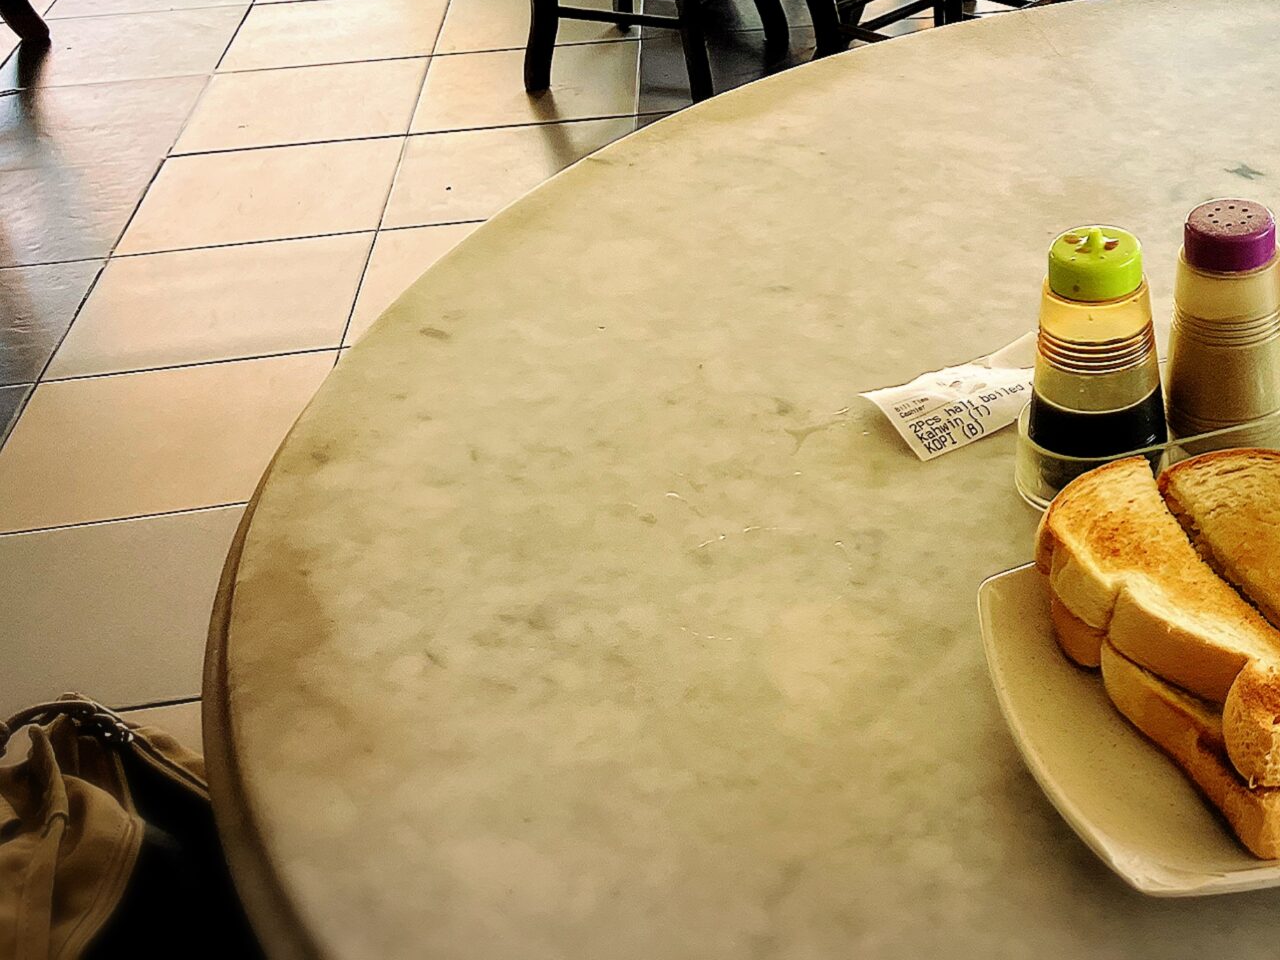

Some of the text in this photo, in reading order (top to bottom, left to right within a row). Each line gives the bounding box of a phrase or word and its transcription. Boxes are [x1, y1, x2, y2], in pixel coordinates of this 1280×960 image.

[908, 382, 1025, 434] 2Pcs half boiled
[916, 404, 991, 443] Kahwin (T)
[923, 420, 985, 454] KOPI (B)
